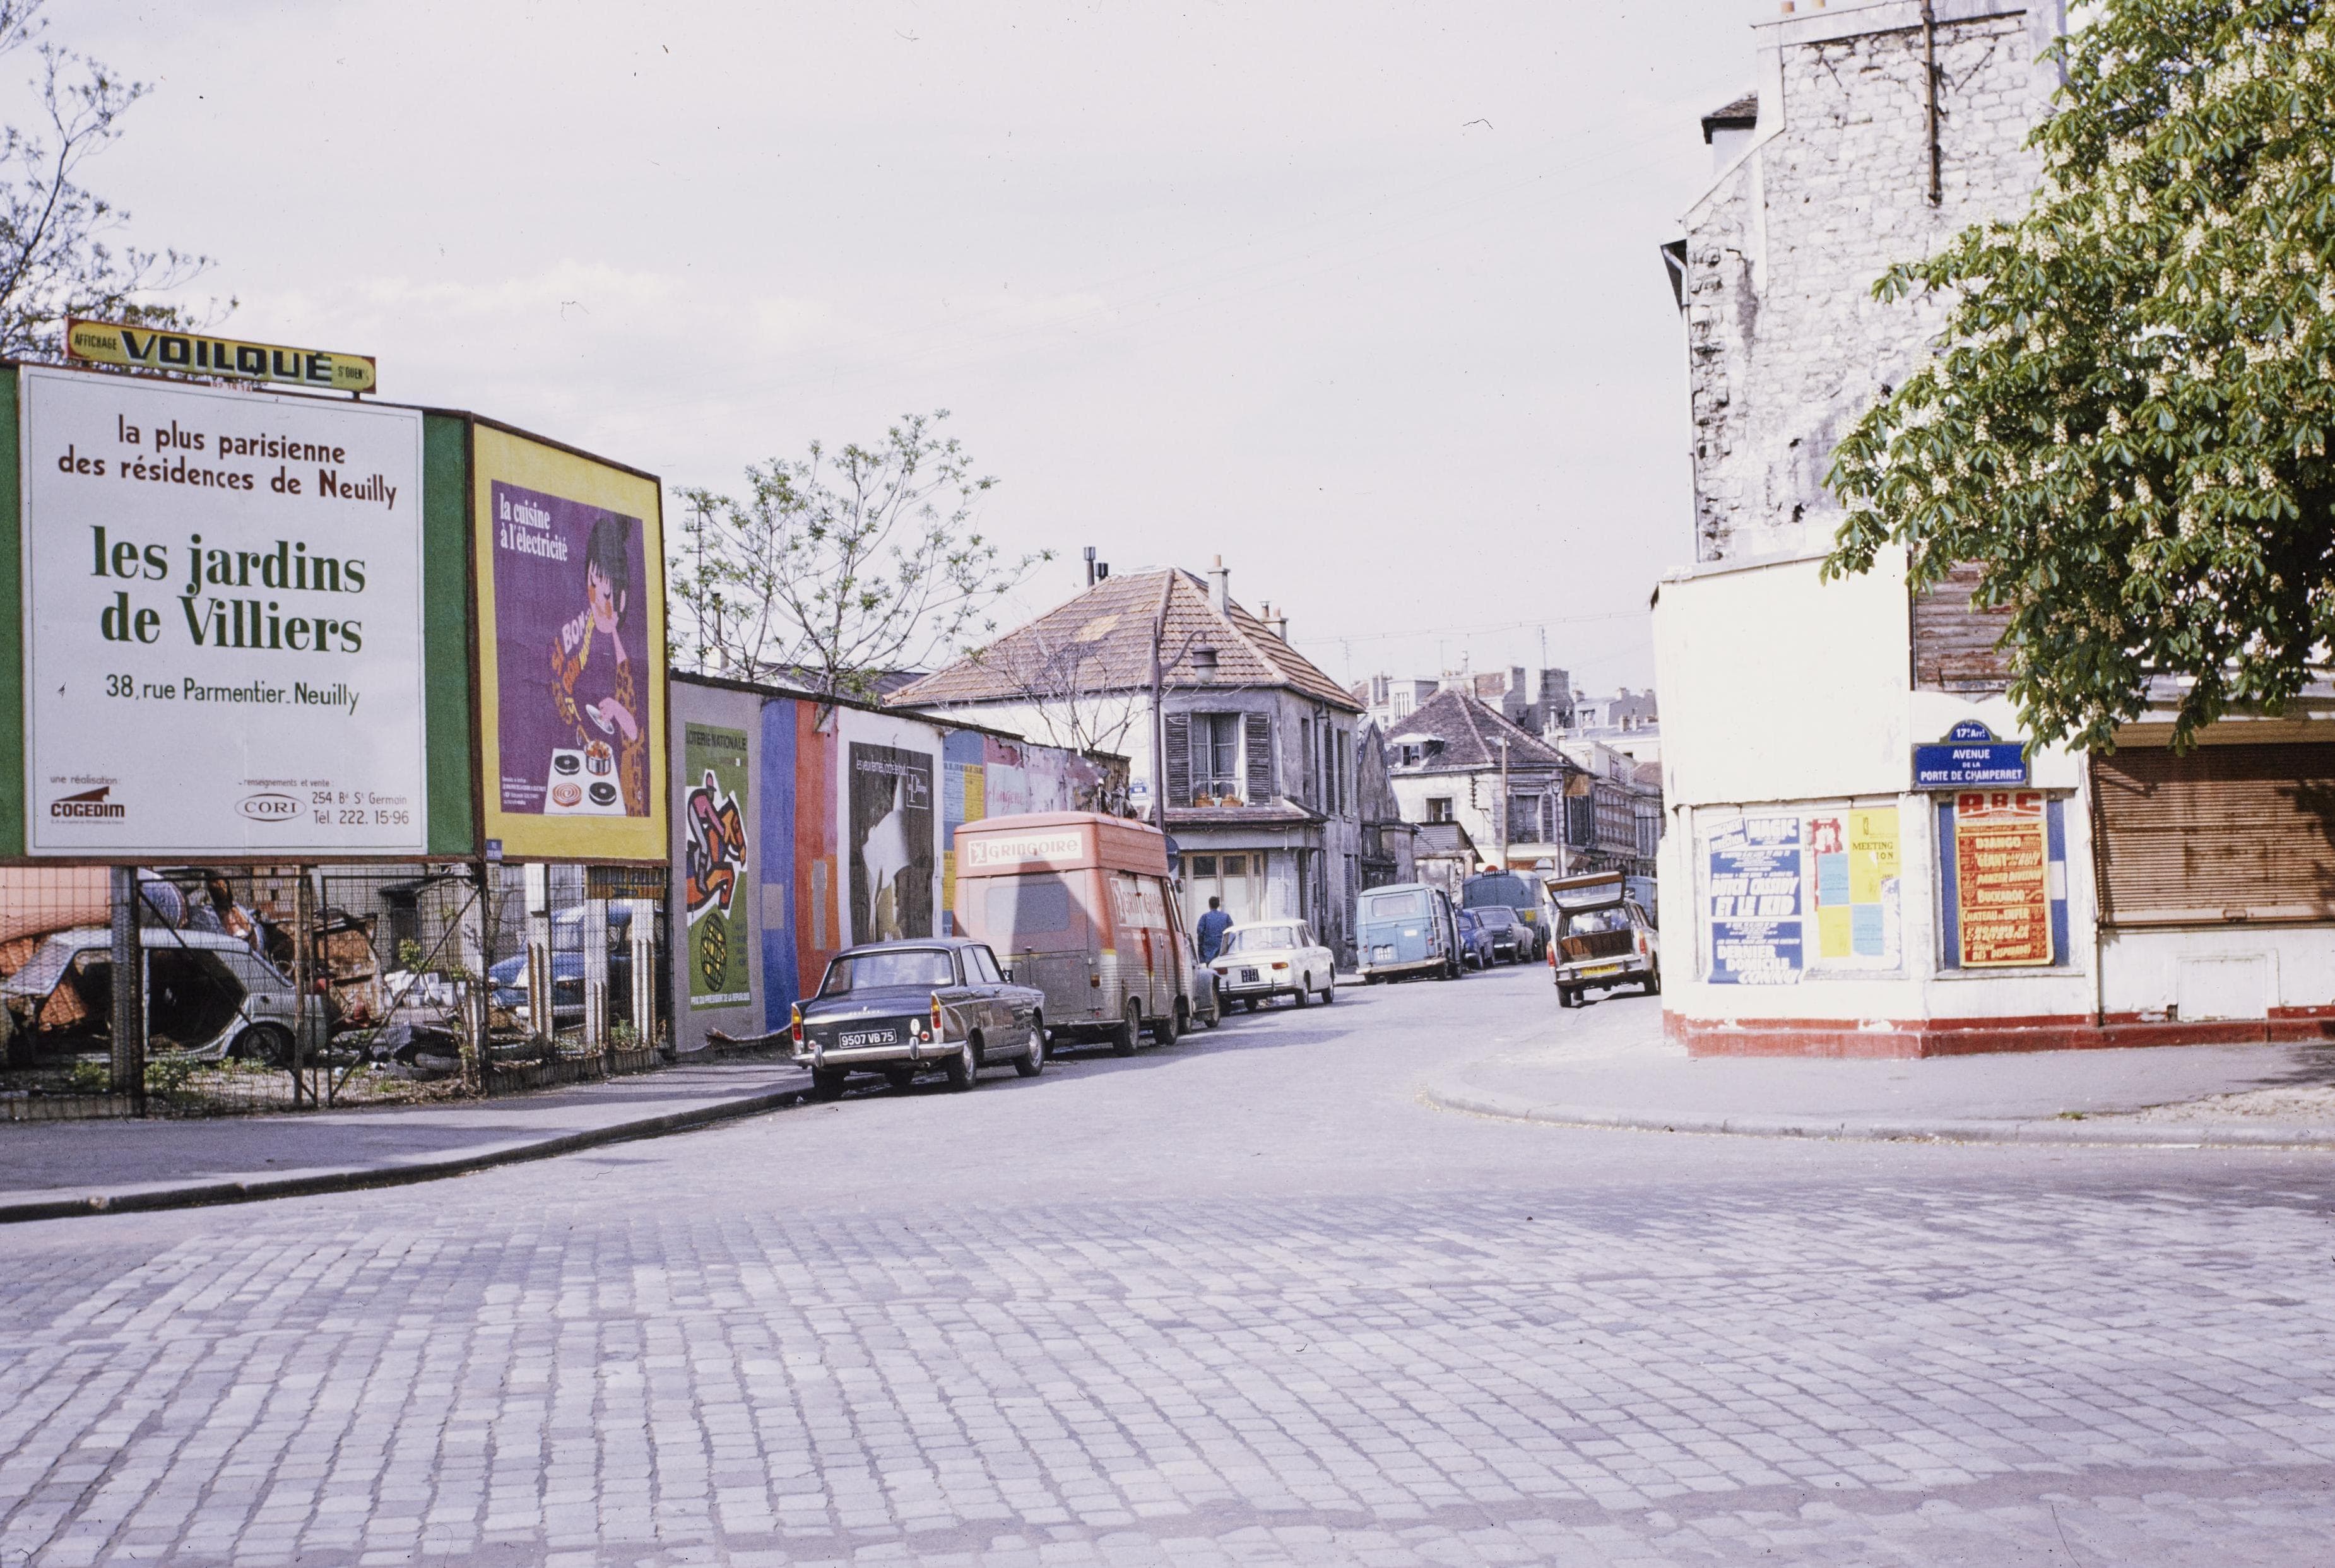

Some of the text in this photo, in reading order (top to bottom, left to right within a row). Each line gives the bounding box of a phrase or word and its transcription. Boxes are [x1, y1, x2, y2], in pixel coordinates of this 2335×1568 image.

[74, 333, 117, 350] AFFICHAGE
[118, 414, 345, 464] la plus parisienne
[58, 444, 397, 510] des résidences de Neuilly
[500, 492, 550, 530] la cuisine
[500, 522, 568, 562] à l'électricité
[90, 526, 366, 596] les jardins
[100, 591, 362, 653] de Villiers
[143, 681, 176, 700] rue
[294, 681, 360, 716] Neuilly
[711, 734, 747, 751] NATIONALE
[1953, 749, 1990, 759] AVENUE
[244, 779, 297, 788] renseignements
[1920, 769, 2023, 781] PORTE DE CHAMPERRET
[244, 801, 297, 813] CORI
[369, 793, 407, 806] Germain
[50, 803, 125, 818] COGEDIM
[1749, 819, 1797, 838] MAGIC
[1852, 842, 1893, 851] MEETING
[1975, 836, 2022, 849] DJANGO
[1737, 895, 1757, 916] LE
[1758, 895, 1795, 916] KID
[1717, 945, 1776, 960] DERNIER
[841, 1031, 894, 1046] 9507 VB 75
